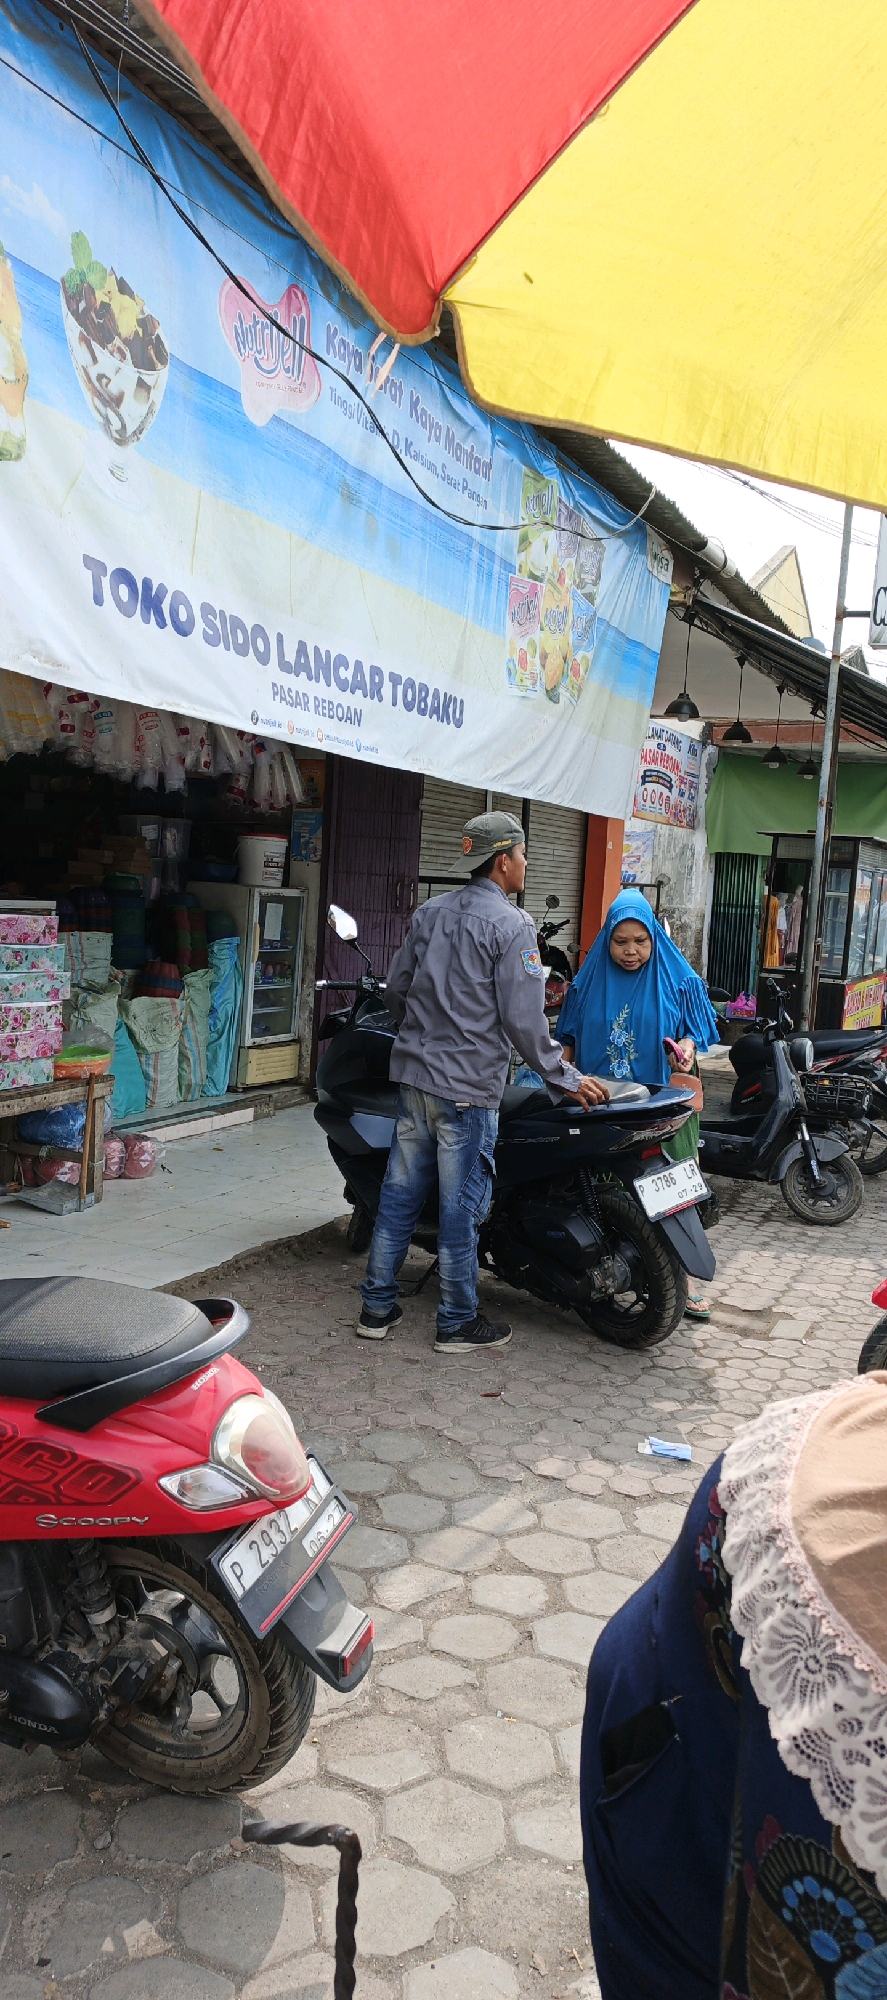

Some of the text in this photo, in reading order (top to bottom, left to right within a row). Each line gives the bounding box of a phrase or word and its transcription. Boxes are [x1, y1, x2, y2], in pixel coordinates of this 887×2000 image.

[234, 310, 307, 381] Nutrijell
[325, 323, 363, 376] Kaya
[409, 389, 443, 446] Kaya
[444, 425, 493, 483] Manfaat
[329, 387, 356, 420] Tinggi
[356, 404, 390, 441] Vita
[404, 437, 440, 479] Kalsium,
[440, 463, 461, 492] Serat
[462, 477, 488, 510] Pangan
[82, 553, 465, 728] TOKO SIDO LANCAR TOBAKU
[271, 682, 363, 727] PASAR REBOAN
[638, 1163, 697, 1197] P 3786 LR
[230, 1561, 245, 1592] P
[249, 1509, 299, 1568] 2932
[8, 1712, 60, 1735] HONDA
